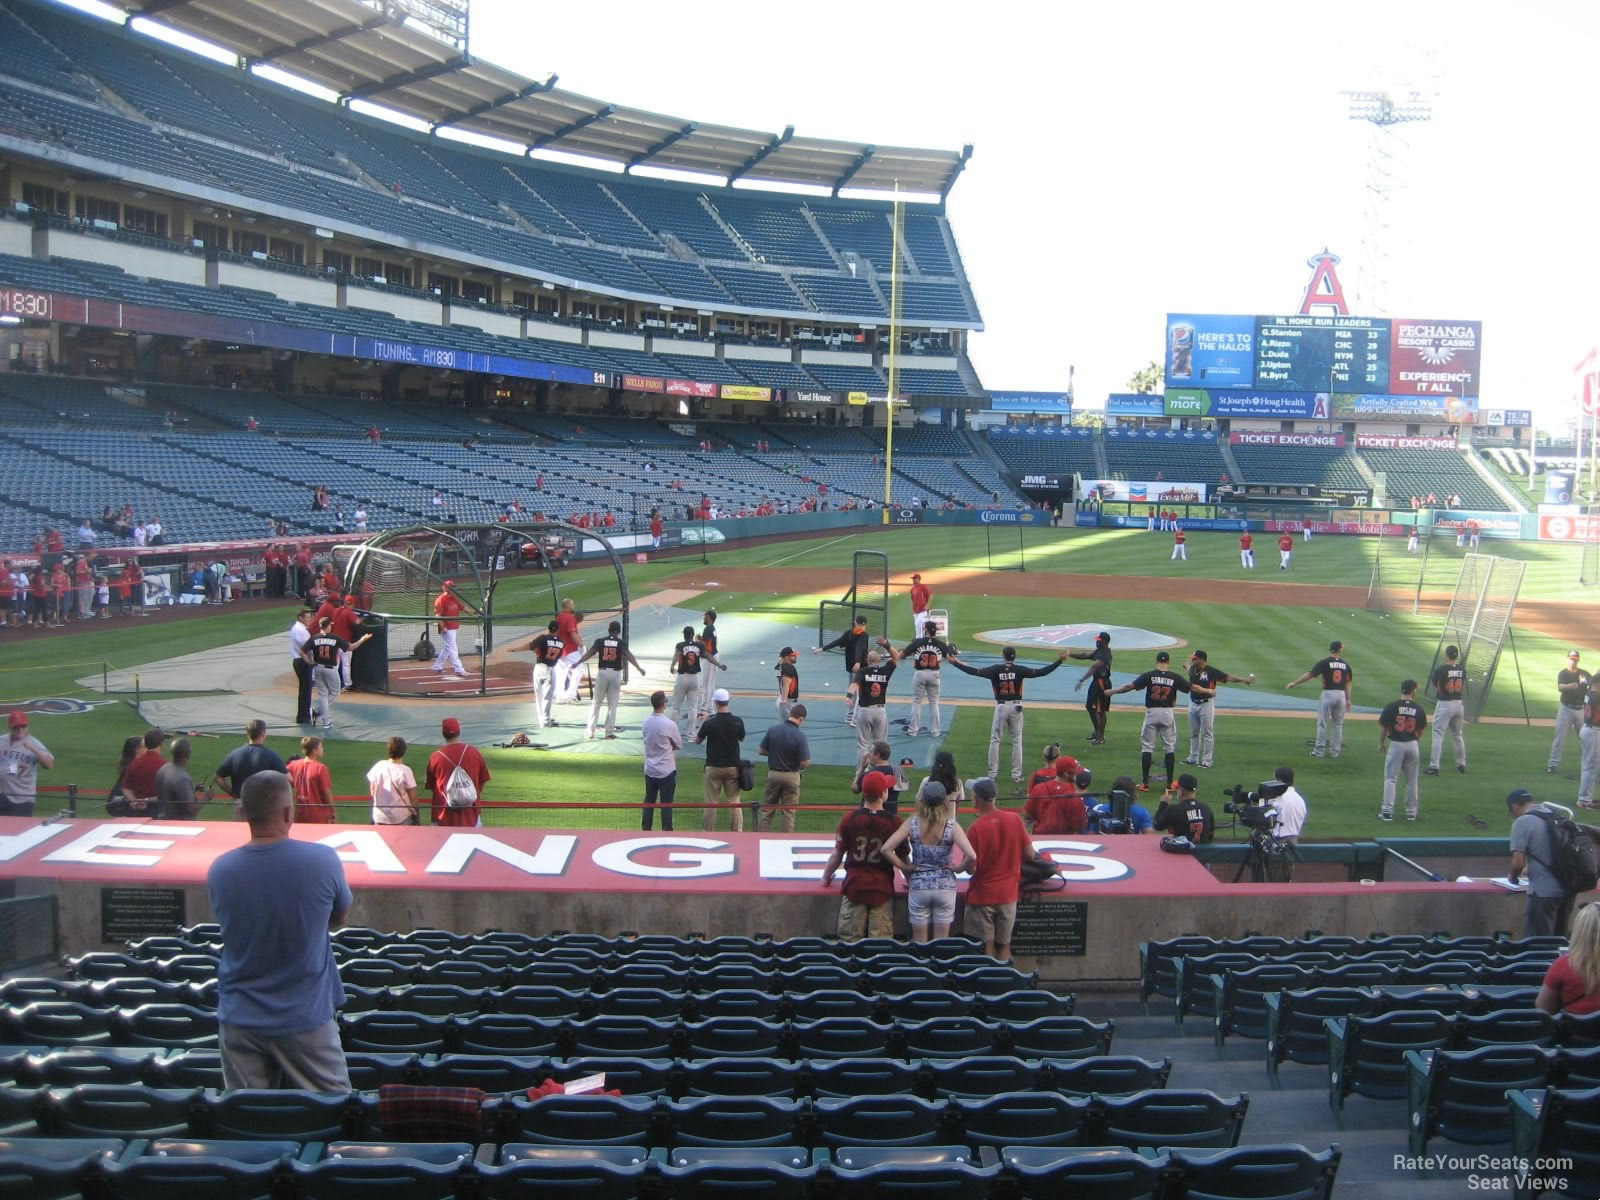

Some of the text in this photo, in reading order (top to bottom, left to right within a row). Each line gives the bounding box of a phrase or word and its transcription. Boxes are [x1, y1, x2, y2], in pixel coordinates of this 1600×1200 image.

[13, 292, 48, 316] 830
[1276, 317, 1287, 325] NL
[1315, 318, 1333, 326] RUN
[1335, 319, 1371, 327] LEADERS
[1262, 329, 1302, 337] G.Stanton
[1367, 331, 1377, 339] 33
[1398, 325, 1475, 338] PECHANGA
[1198, 332, 1251, 343] HERE'S TO
[1398, 337, 1475, 347] RESORT CASINO
[1198, 342, 1251, 352] THE HALOS
[1367, 342, 1377, 350] 29
[437, 350, 454, 366] 830
[1261, 350, 1289, 358] L.Duda
[1334, 352, 1353, 360] NYM
[1260, 372, 1288, 381] M.Byrd
[625, 378, 644, 387] WELLS
[645, 379, 663, 388] FARGO
[1416, 382, 1453, 392] IT ALL
[797, 392, 832, 402] Yard House
[1281, 398, 1306, 407] Health
[1360, 398, 1389, 407] Artfully
[1391, 399, 1418, 407] Crafted
[1170, 399, 1202, 410] more
[1239, 434, 1337, 446] TICKET EXCHANGE
[1358, 438, 1456, 449] TICKET EXCHANGE
[1020, 475, 1047, 485] JMG
[981, 511, 1016, 523] Corona
[319, 645, 330, 657] 11
[870, 682, 881, 697] 9
[1186, 808, 1204, 821] HILL
[1190, 822, 1204, 844] 7
[852, 835, 884, 864] 32
[330, 829, 1133, 882] ANGES
